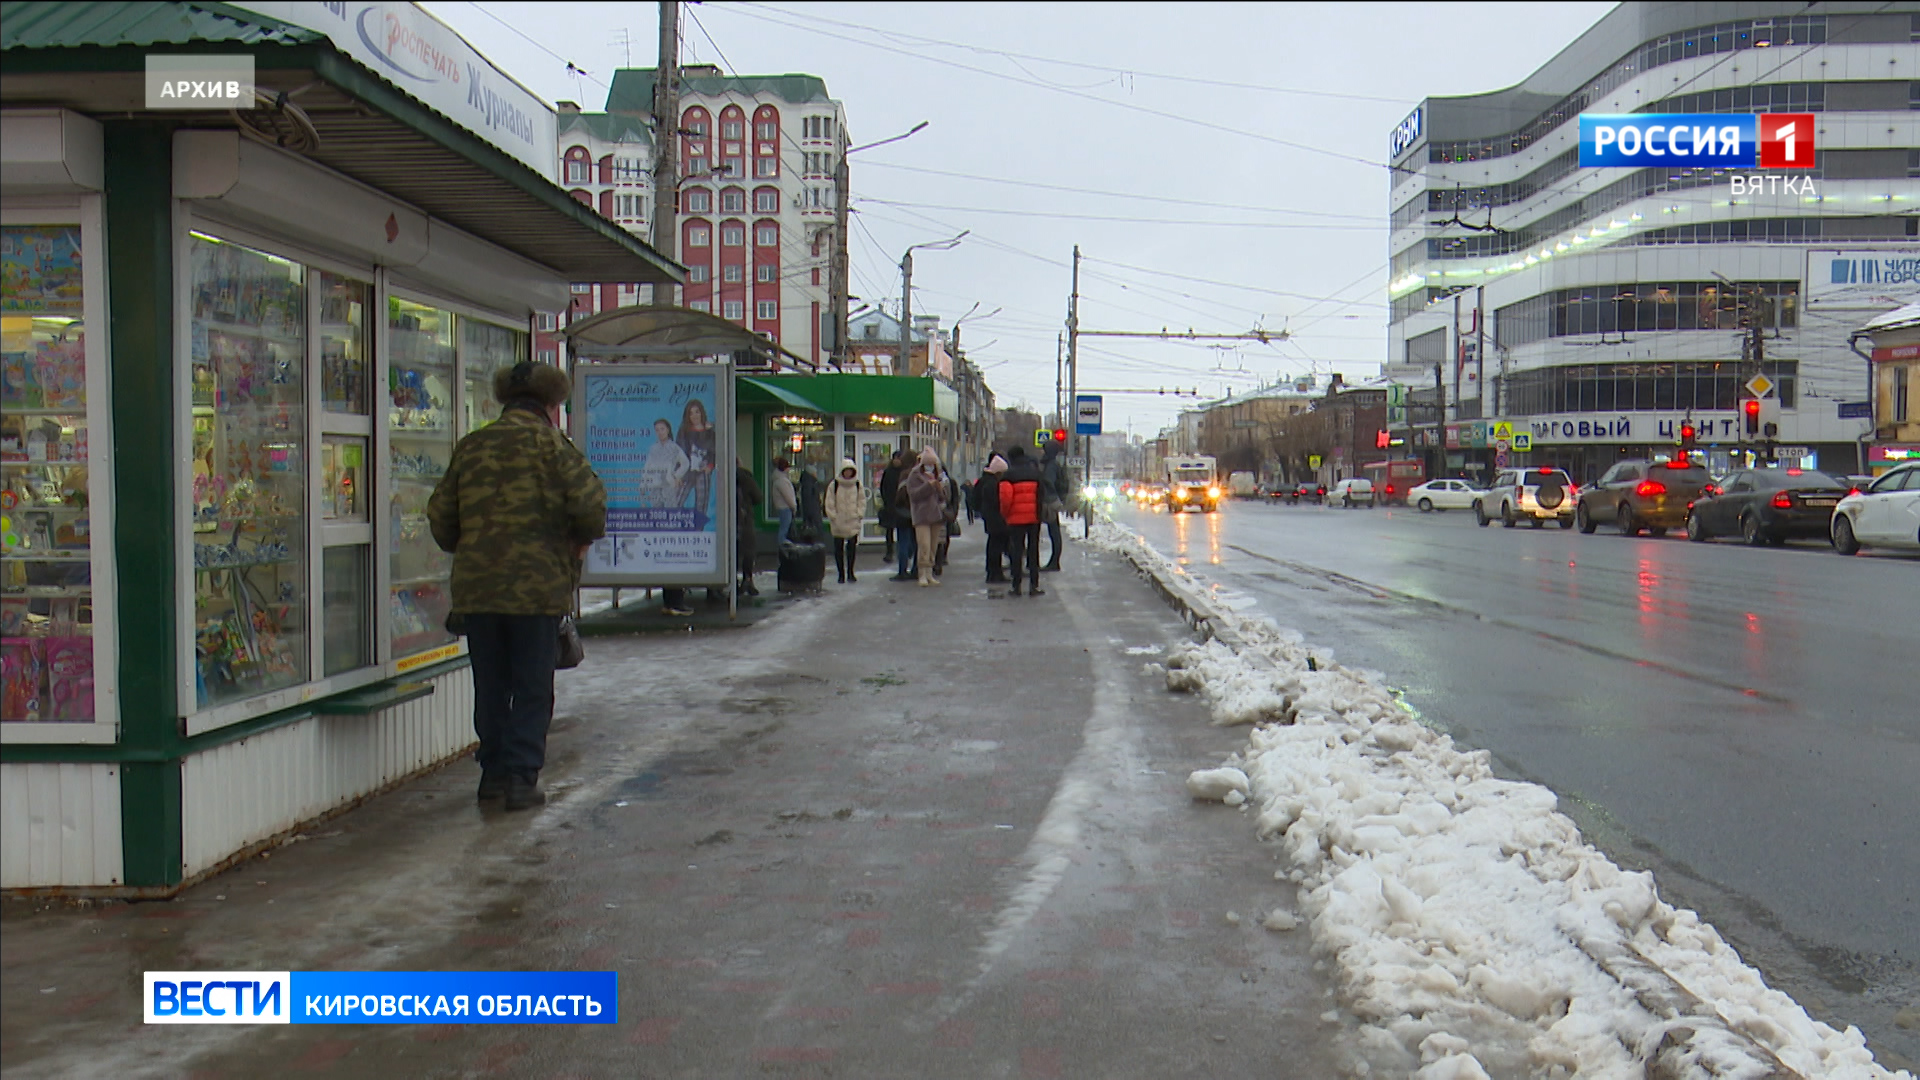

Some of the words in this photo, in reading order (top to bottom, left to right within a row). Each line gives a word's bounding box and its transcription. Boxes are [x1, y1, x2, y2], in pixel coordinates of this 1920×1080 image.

[466, 61, 534, 146] Журналы
[1391, 107, 1421, 159] КРЫМ
[590, 425, 636, 437] Поспеши
[640, 427, 651, 437] за
[1531, 415, 1631, 438] ТОРГОВЫЙ
[1658, 419, 1740, 438] ЦНТ
[590, 453, 647, 462] новинками
[1068, 457, 1086, 466] СТО
